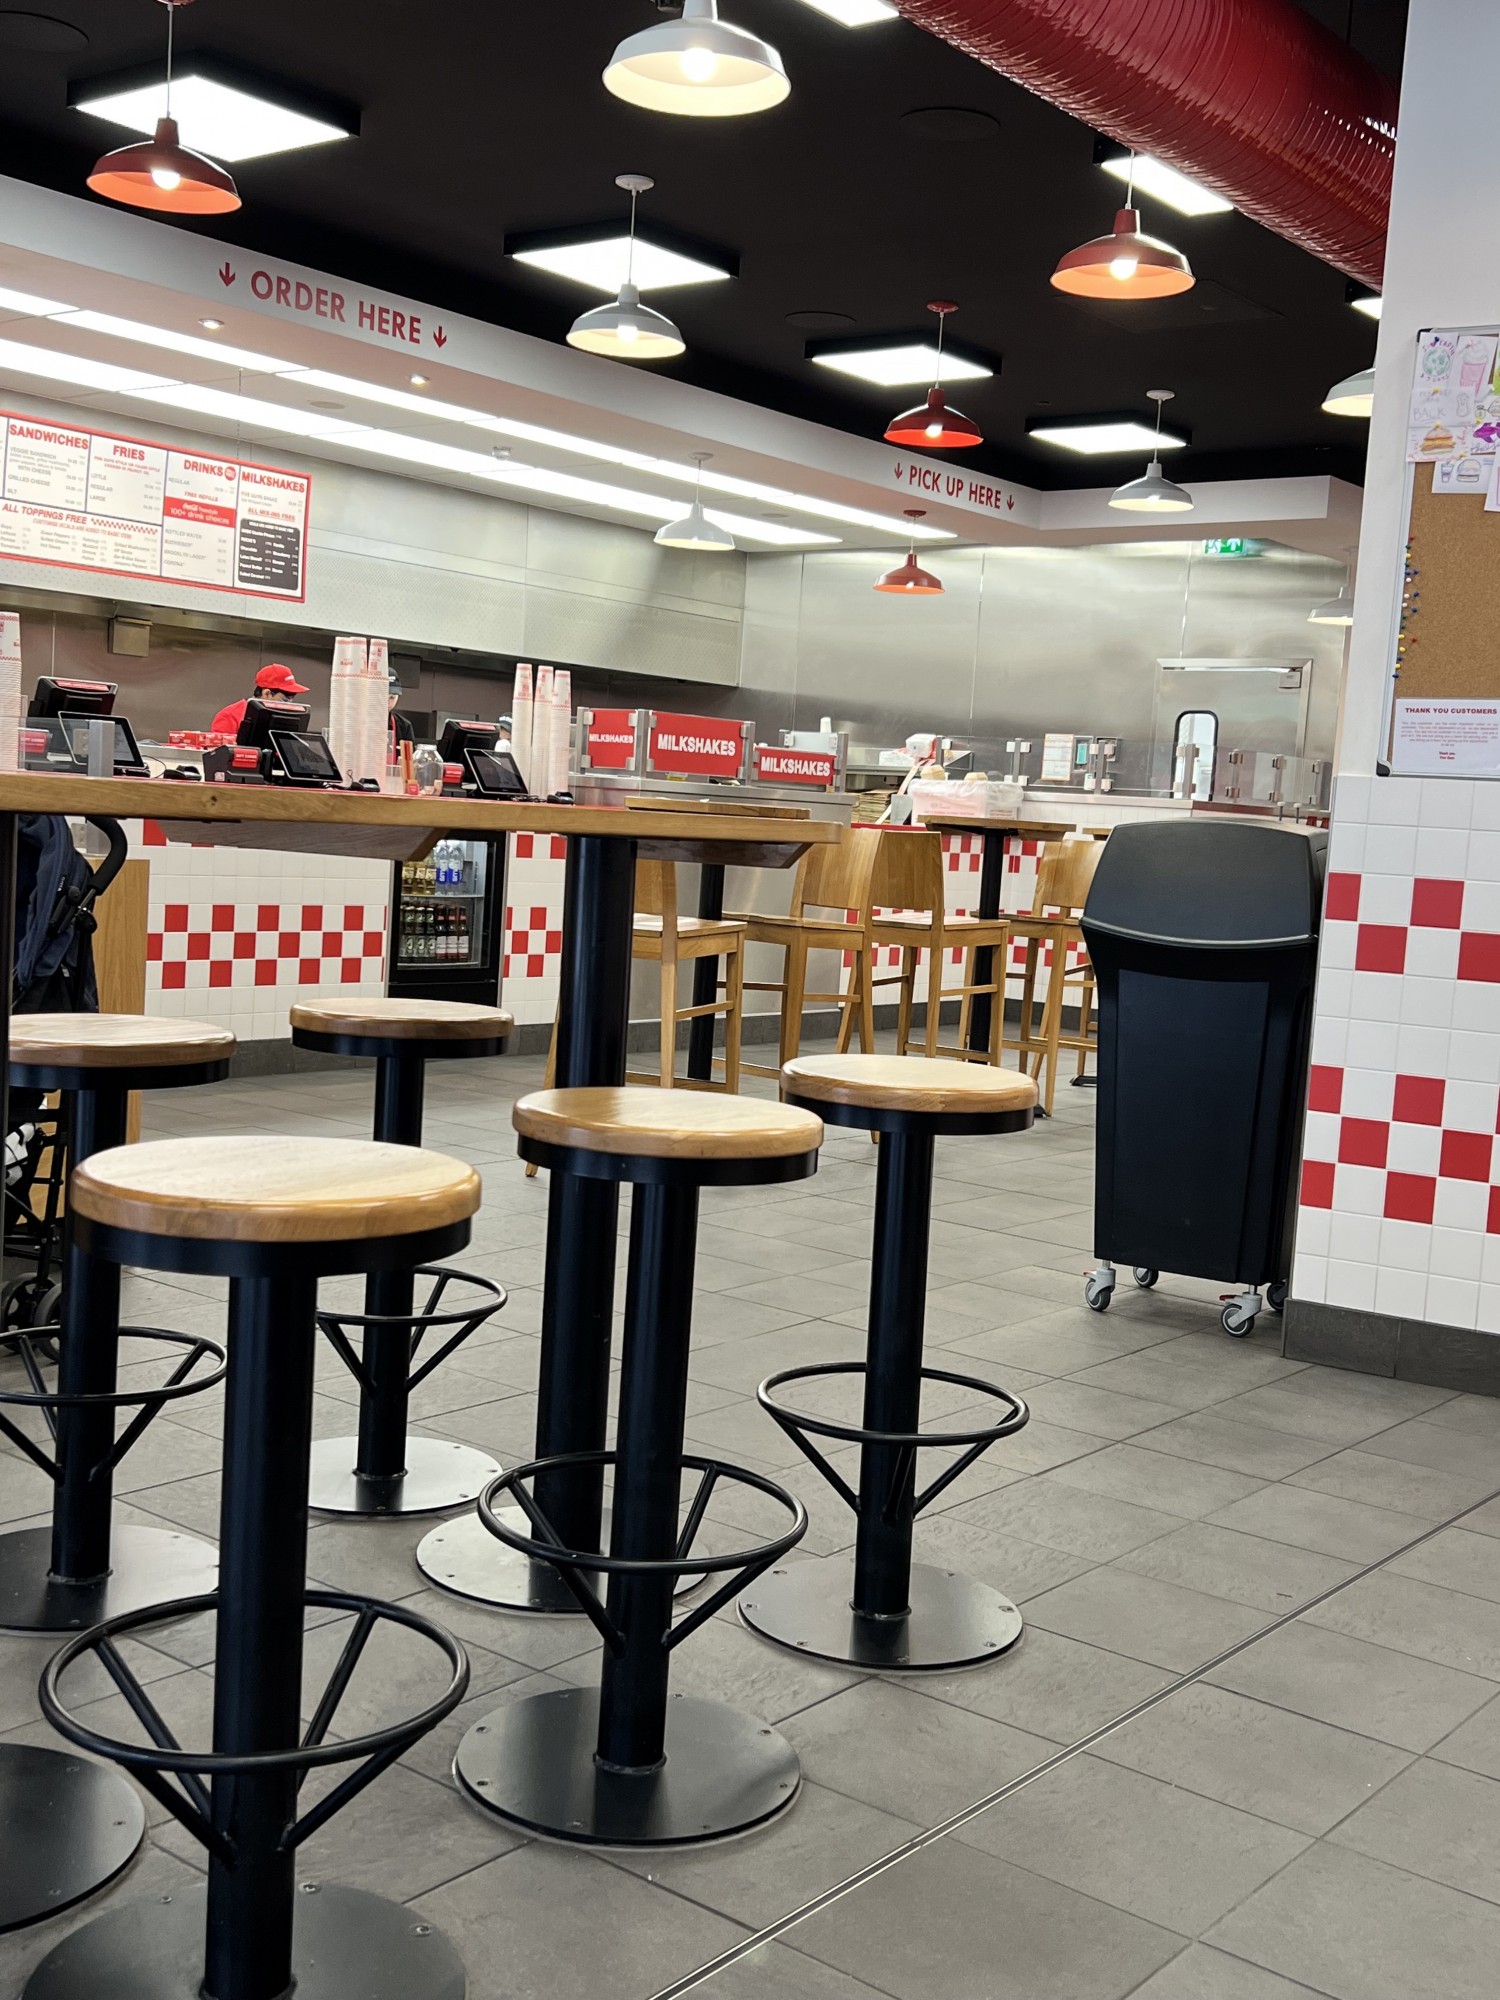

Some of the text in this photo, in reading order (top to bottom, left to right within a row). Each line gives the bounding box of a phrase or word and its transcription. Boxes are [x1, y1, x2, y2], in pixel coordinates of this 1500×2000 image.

[250, 270, 421, 345] ORDER HERE
[1413, 407, 1447, 421] BACK
[9, 424, 89, 450] SANDWICHES
[113, 445, 145, 461] FRIES
[184, 459, 223, 477] DRINKS
[241, 471, 305, 493] MILKSHAKES
[909, 465, 1002, 510] PICK UP HERE
[2, 503, 88, 525] ALL TOPPINGS FREE
[170, 507, 186, 516] 100+
[188, 510, 204, 520] drink
[205, 514, 230, 525] choices
[588, 733, 634, 744] MILKSHAKES
[657, 733, 736, 757] MILKSHAKES
[760, 756, 831, 777] MILKSHAKES
